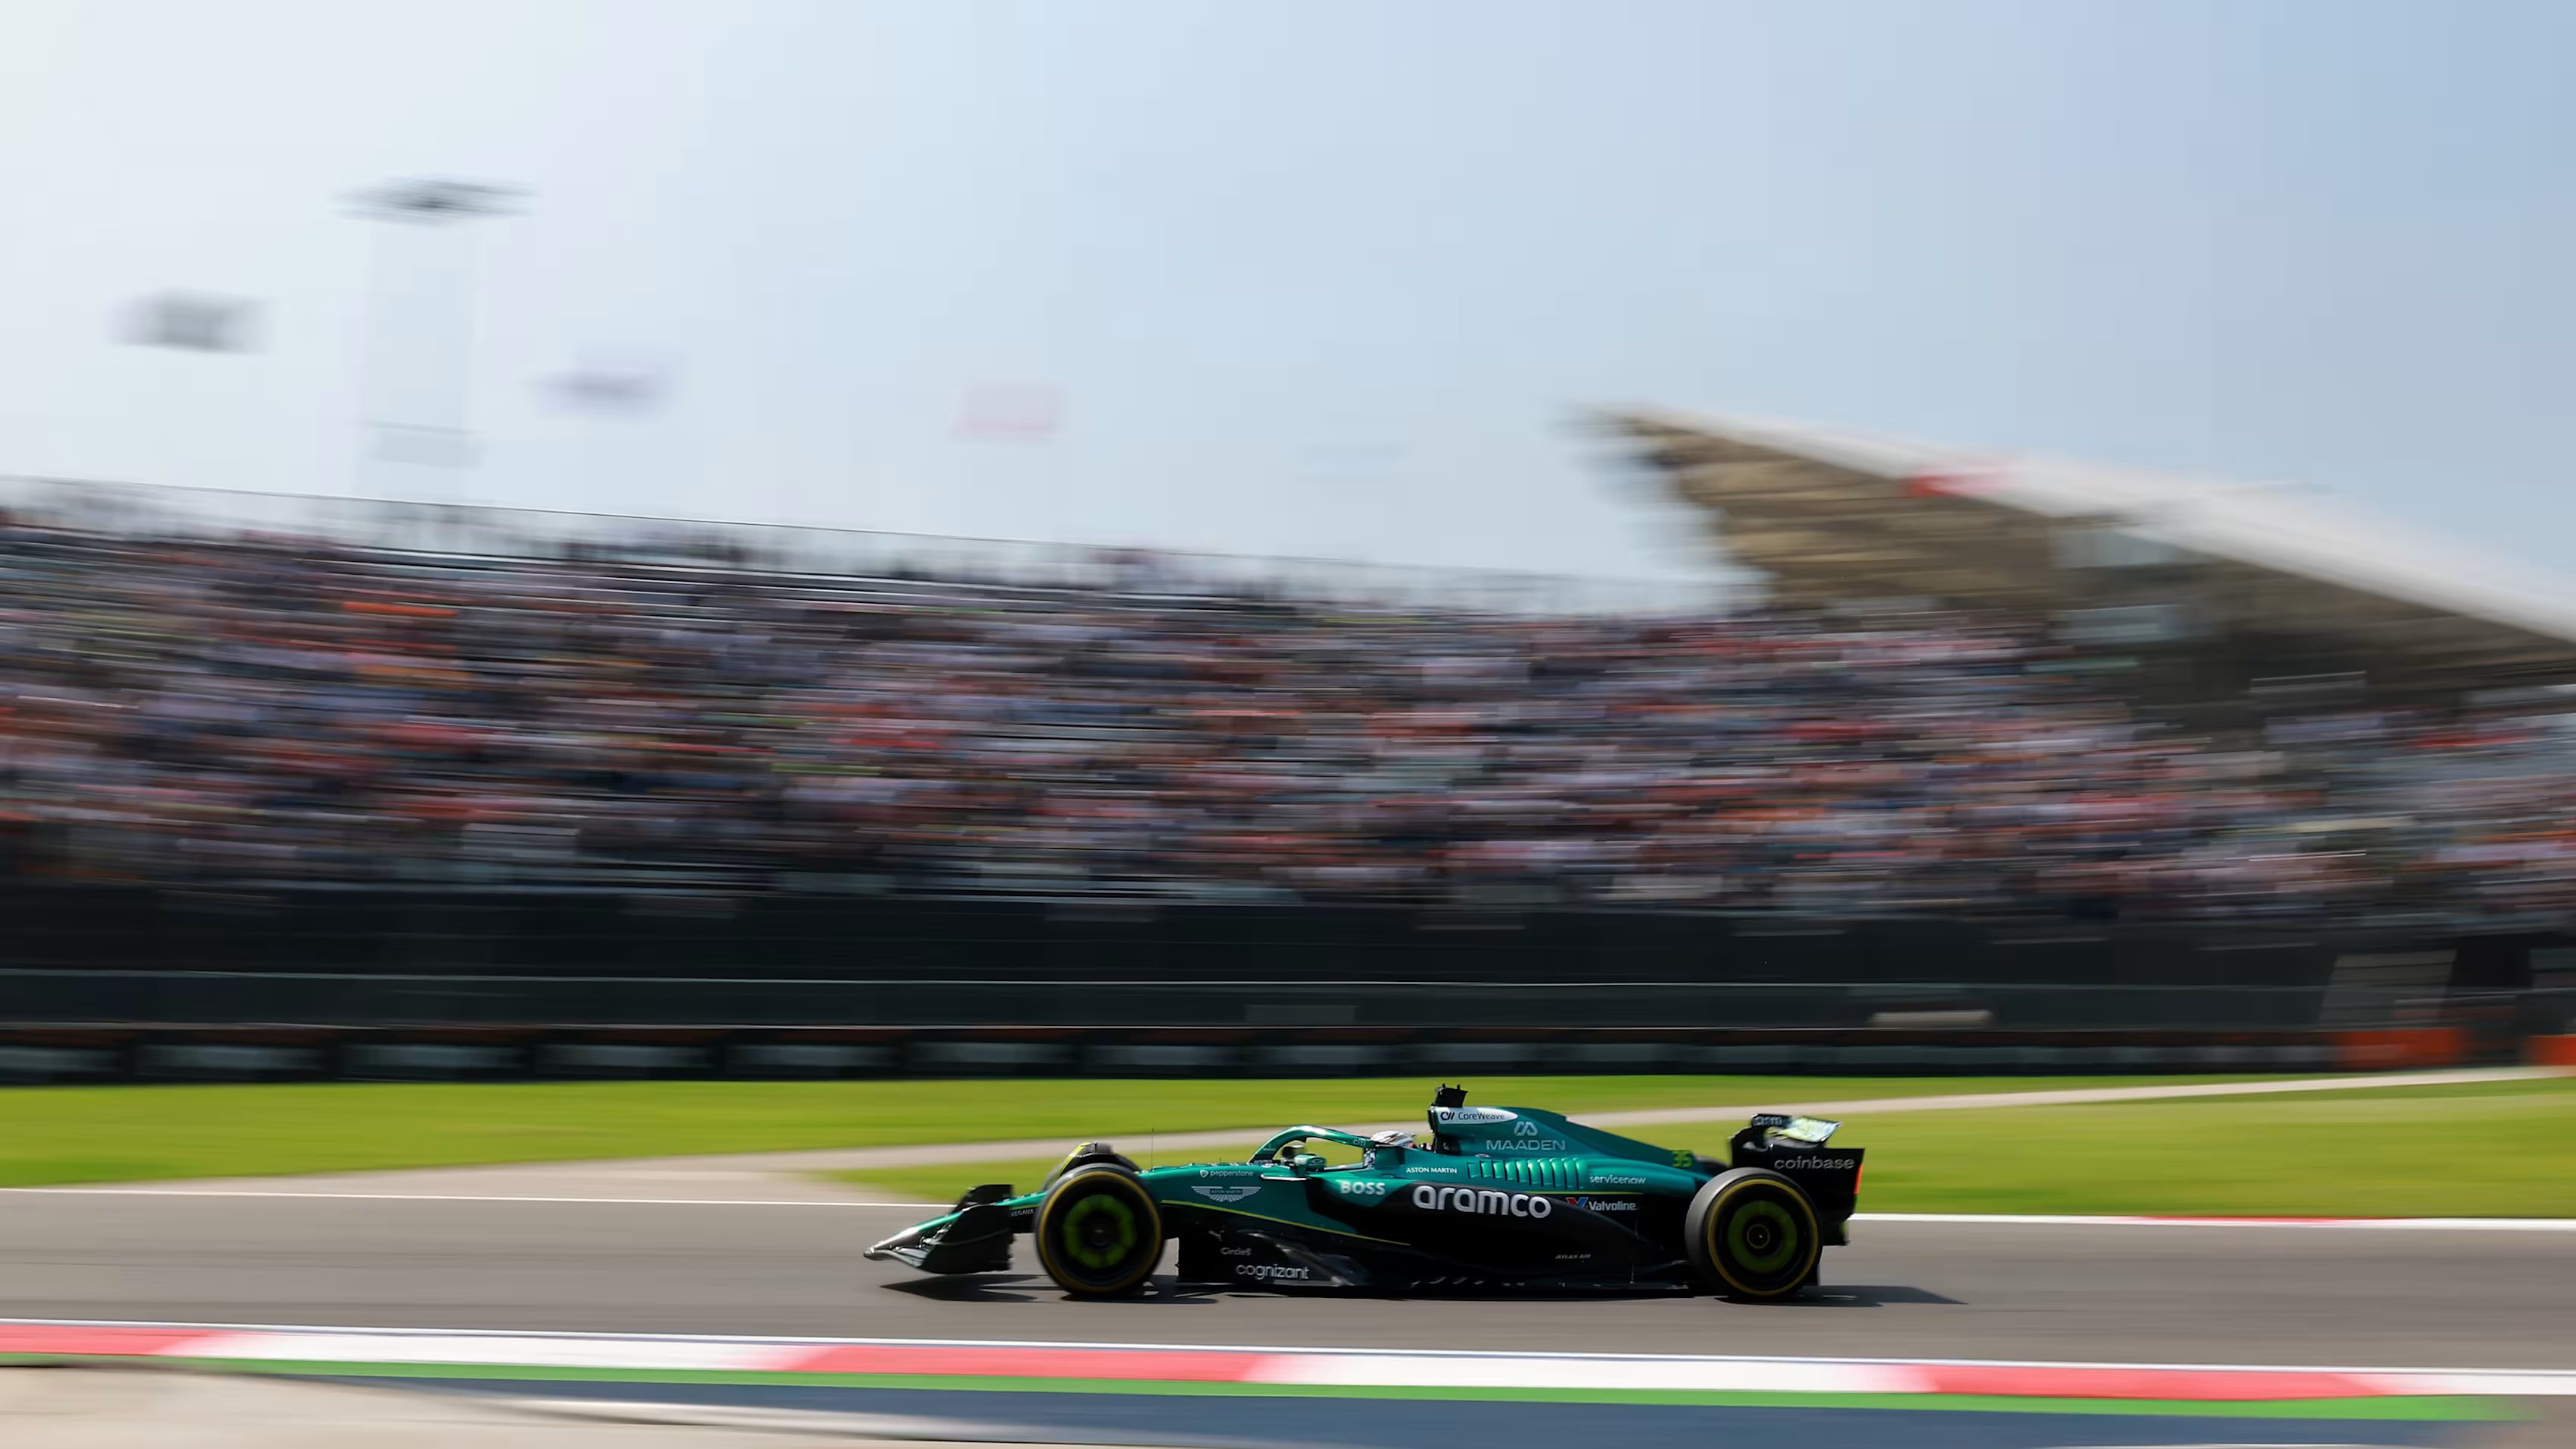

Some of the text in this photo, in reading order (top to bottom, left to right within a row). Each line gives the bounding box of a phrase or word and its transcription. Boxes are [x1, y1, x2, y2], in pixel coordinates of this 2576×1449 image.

[1458, 1112, 1506, 1120] CoreWeave
[1753, 1116, 1782, 1126] arm
[1353, 1138, 1366, 1147] citi
[1486, 1140, 1565, 1151] MAADEN
[1774, 1155, 1855, 1170] coinbase
[1589, 1174, 1646, 1185] servicenow
[1340, 1181, 1386, 1196] BOSS
[1412, 1185, 1552, 1219] aramco
[1588, 1200, 1637, 1211] Valvoline
[1236, 1264, 1310, 1280] cognizant
